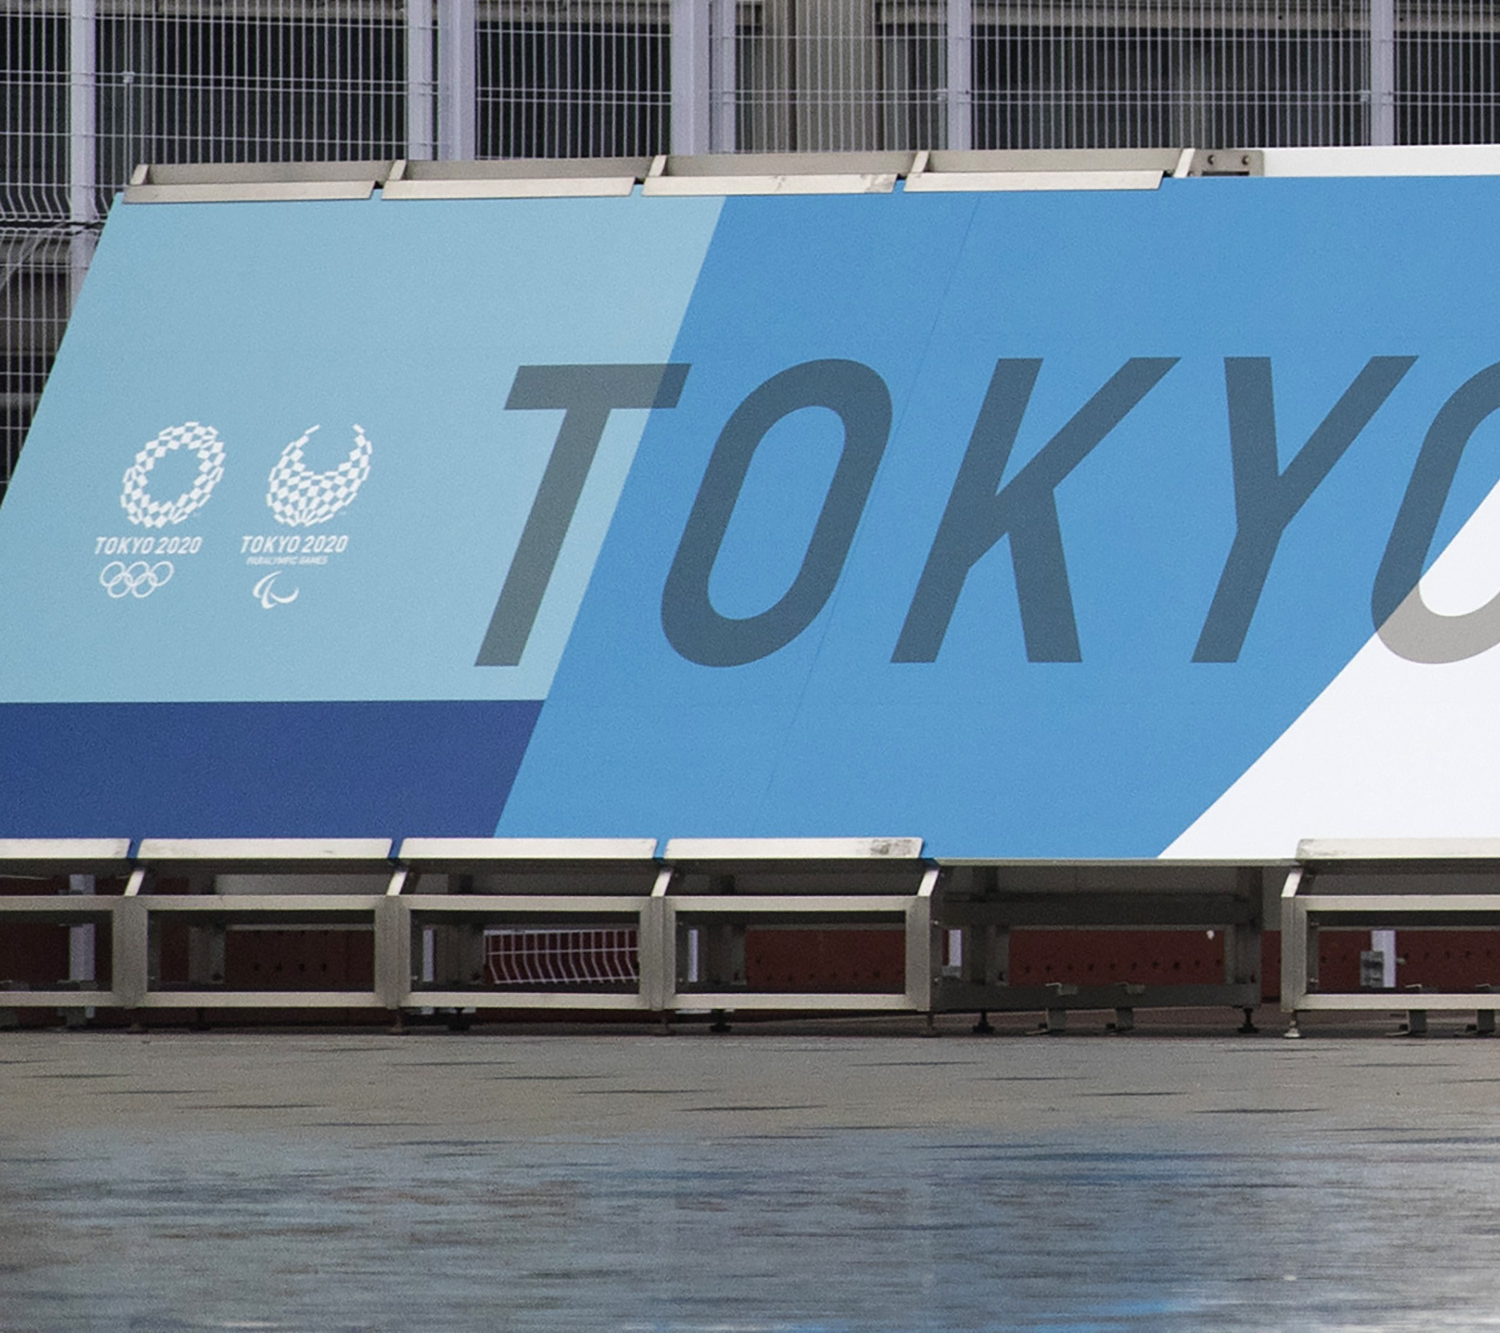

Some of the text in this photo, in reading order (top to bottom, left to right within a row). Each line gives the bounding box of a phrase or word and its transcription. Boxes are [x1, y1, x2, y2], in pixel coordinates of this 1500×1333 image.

[94, 536, 203, 555] TOKYO 2020
[240, 535, 349, 554] TOKYO 2020
[246, 555, 329, 566] PARALYMPIC GAMES
